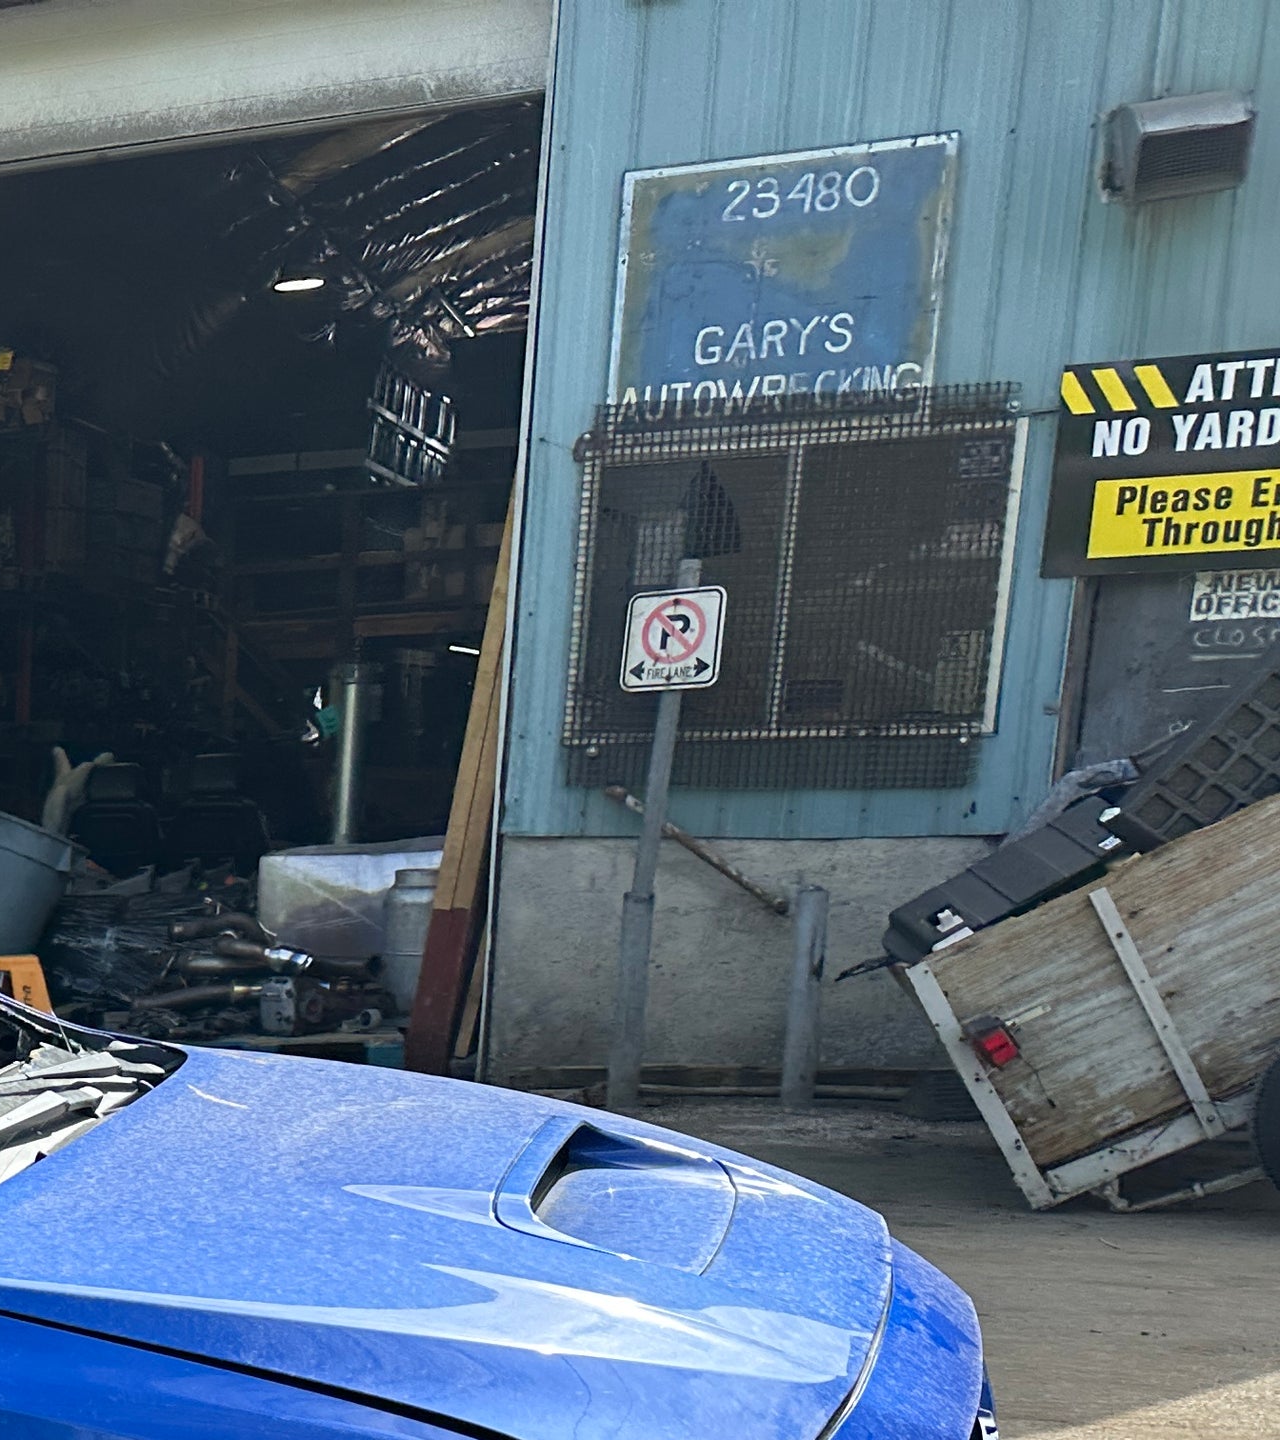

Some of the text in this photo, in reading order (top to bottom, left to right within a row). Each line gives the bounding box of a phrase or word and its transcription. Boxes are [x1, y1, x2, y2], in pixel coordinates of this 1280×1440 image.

[722, 165, 881, 222] 23480
[694, 312, 855, 366] GARY'S
[1092, 407, 1280, 458] NO YARD
[1115, 484, 1234, 516] Please
[1142, 510, 1280, 548] Through
[646, 667, 665, 680] FIRE
